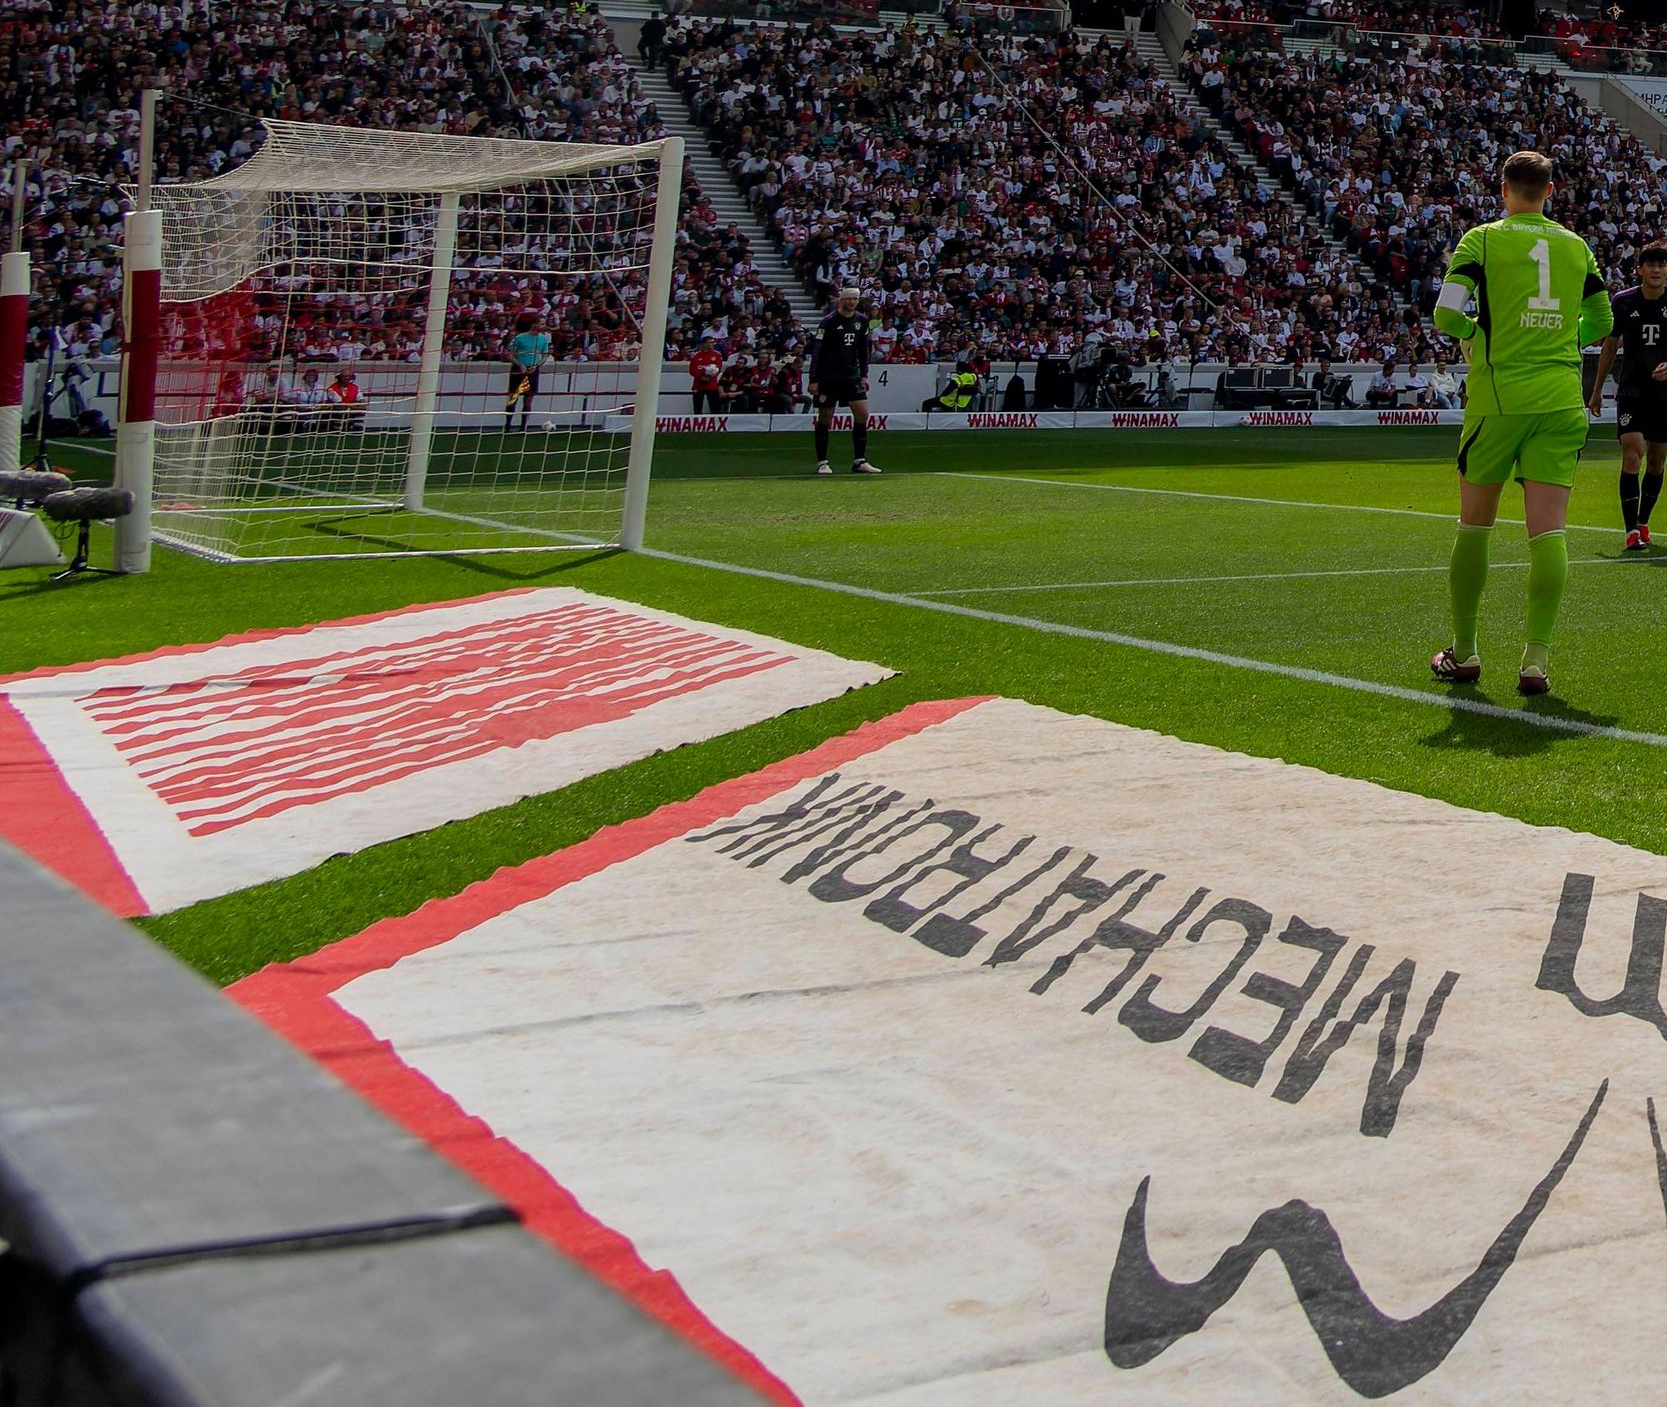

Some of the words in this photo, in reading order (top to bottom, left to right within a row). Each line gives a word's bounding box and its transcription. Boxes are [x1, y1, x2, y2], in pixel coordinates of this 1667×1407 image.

[1527, 238, 1560, 311] 1
[1520, 312, 1564, 330] NEUER
[878, 370, 889, 387] 4
[967, 413, 1038, 428] WINAMAX
[1112, 413, 1179, 428] WINAMAX
[1249, 412, 1313, 426] WINAMAX
[1377, 412, 1439, 425] WINAMAX
[685, 773, 1459, 1138] MECHATRONIK
